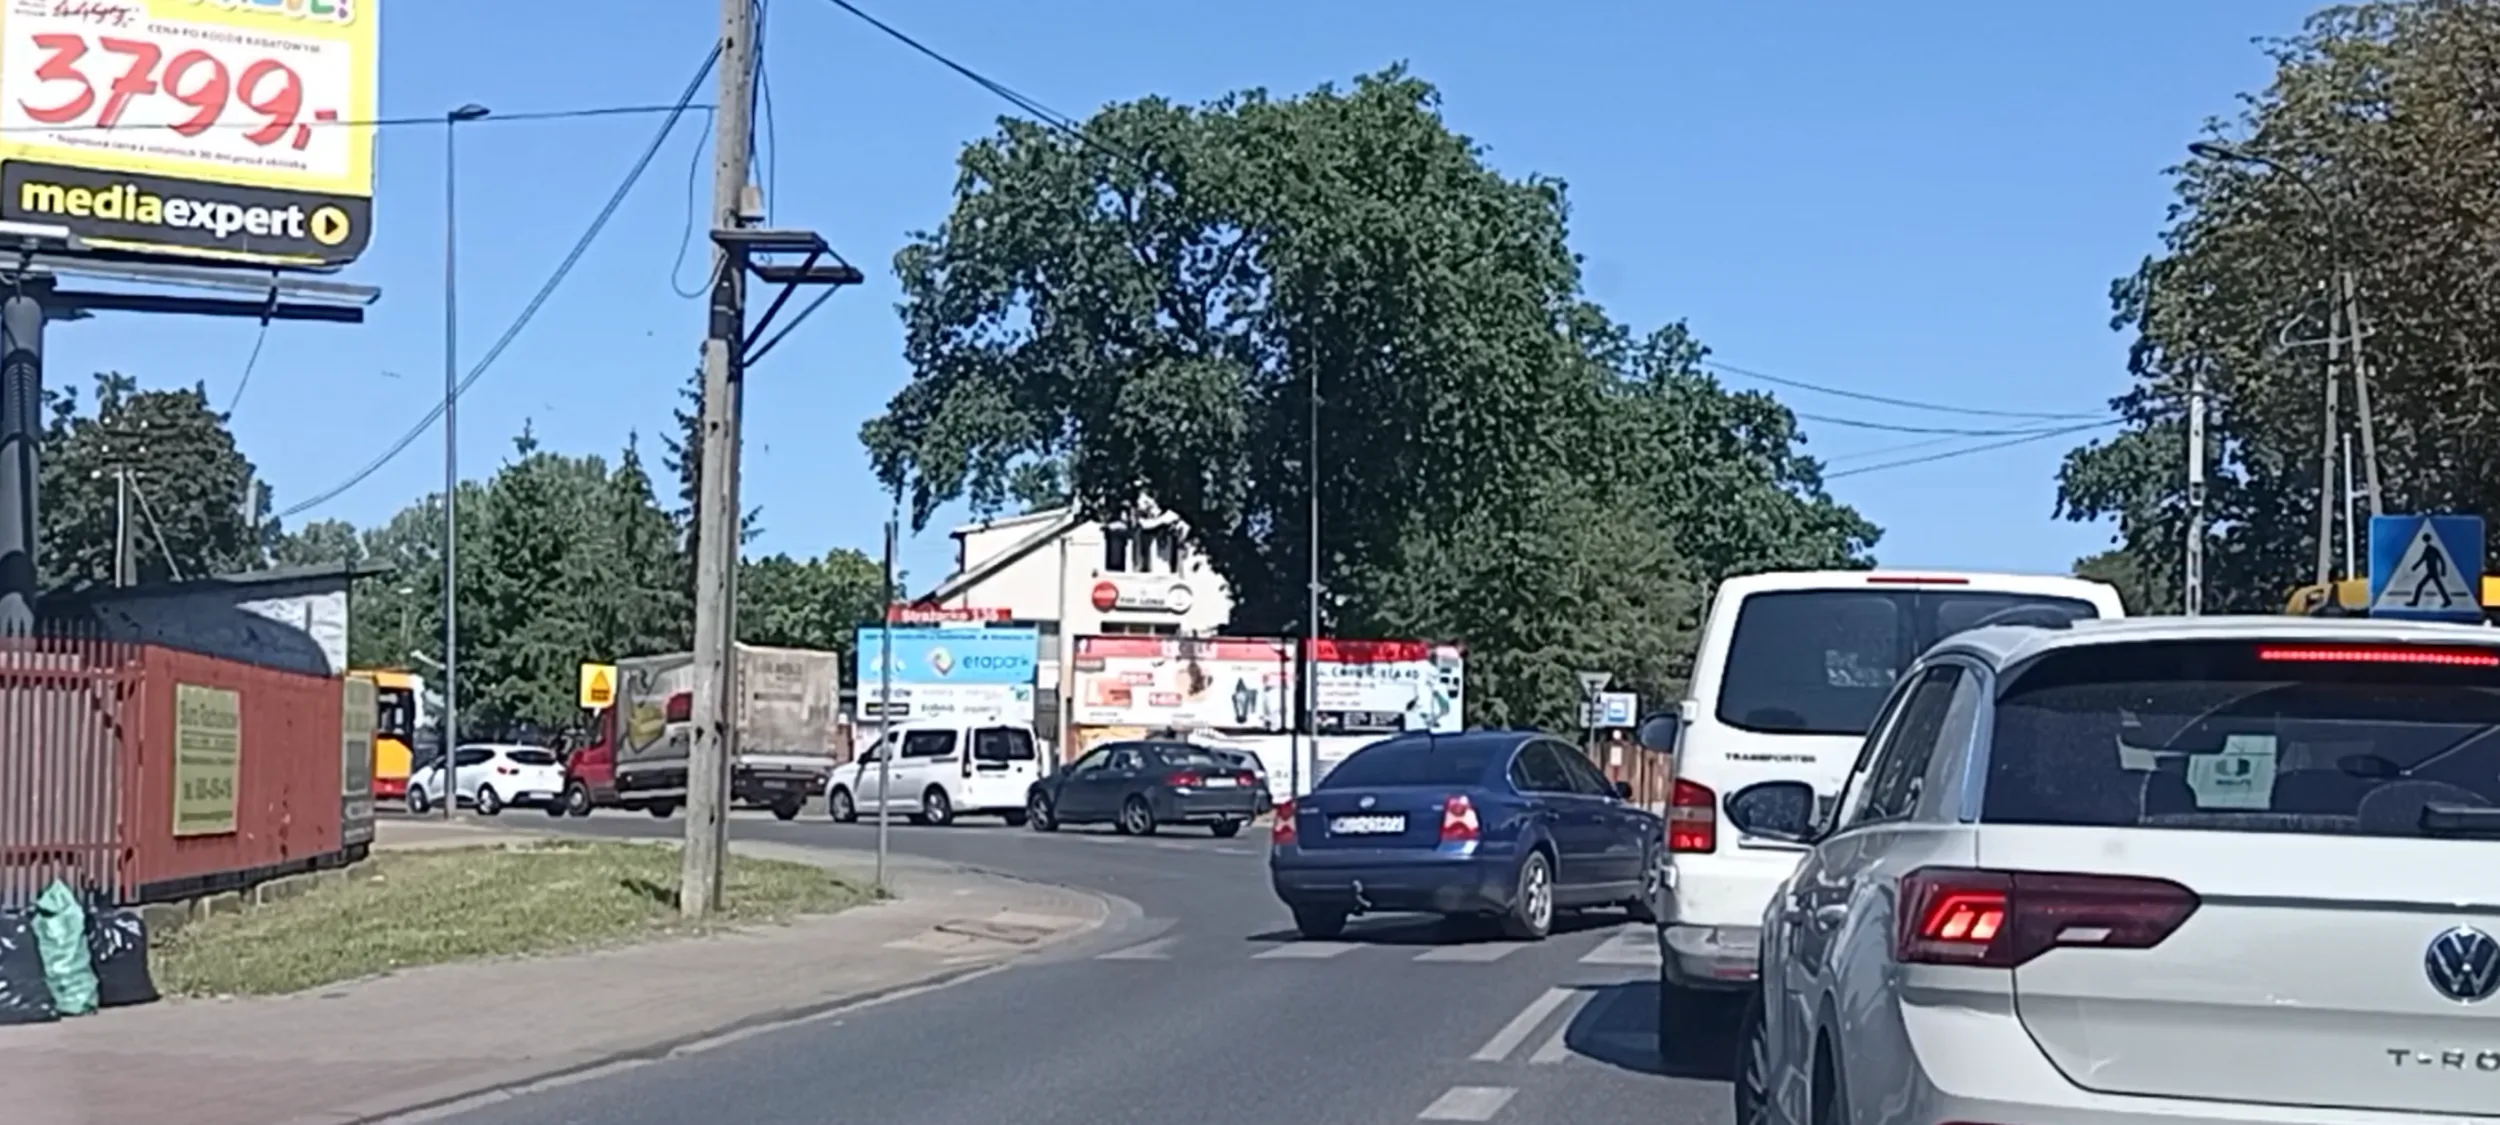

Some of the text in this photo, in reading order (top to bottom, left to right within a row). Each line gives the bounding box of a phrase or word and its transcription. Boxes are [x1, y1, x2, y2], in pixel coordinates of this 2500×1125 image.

[147, 23, 180, 36] CENA
[182, 27, 200, 39] PO
[246, 35, 321, 54] RABATOWYM
[21, 181, 306, 238] mediaexpert
